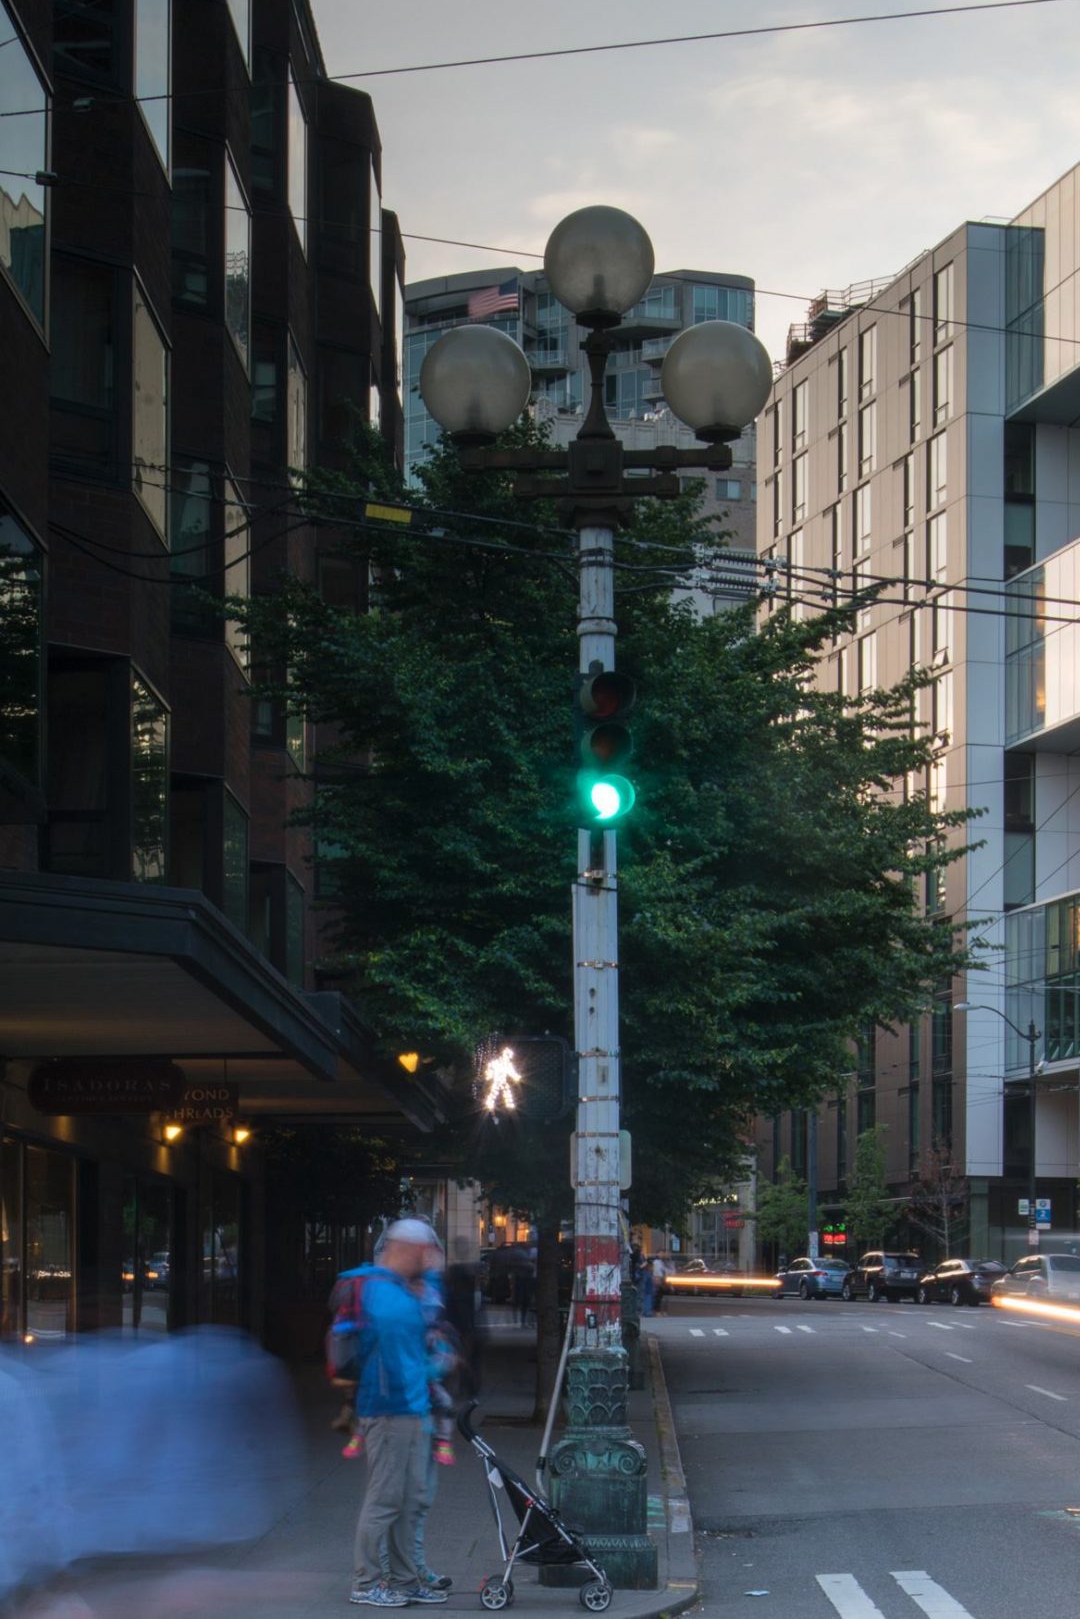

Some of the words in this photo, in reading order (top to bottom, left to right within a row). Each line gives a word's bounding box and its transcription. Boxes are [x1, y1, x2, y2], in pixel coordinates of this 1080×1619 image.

[43, 1078, 171, 1092] ISADORAS
[184, 1088, 230, 1101] YOND
[173, 1106, 234, 1119] HREADS
